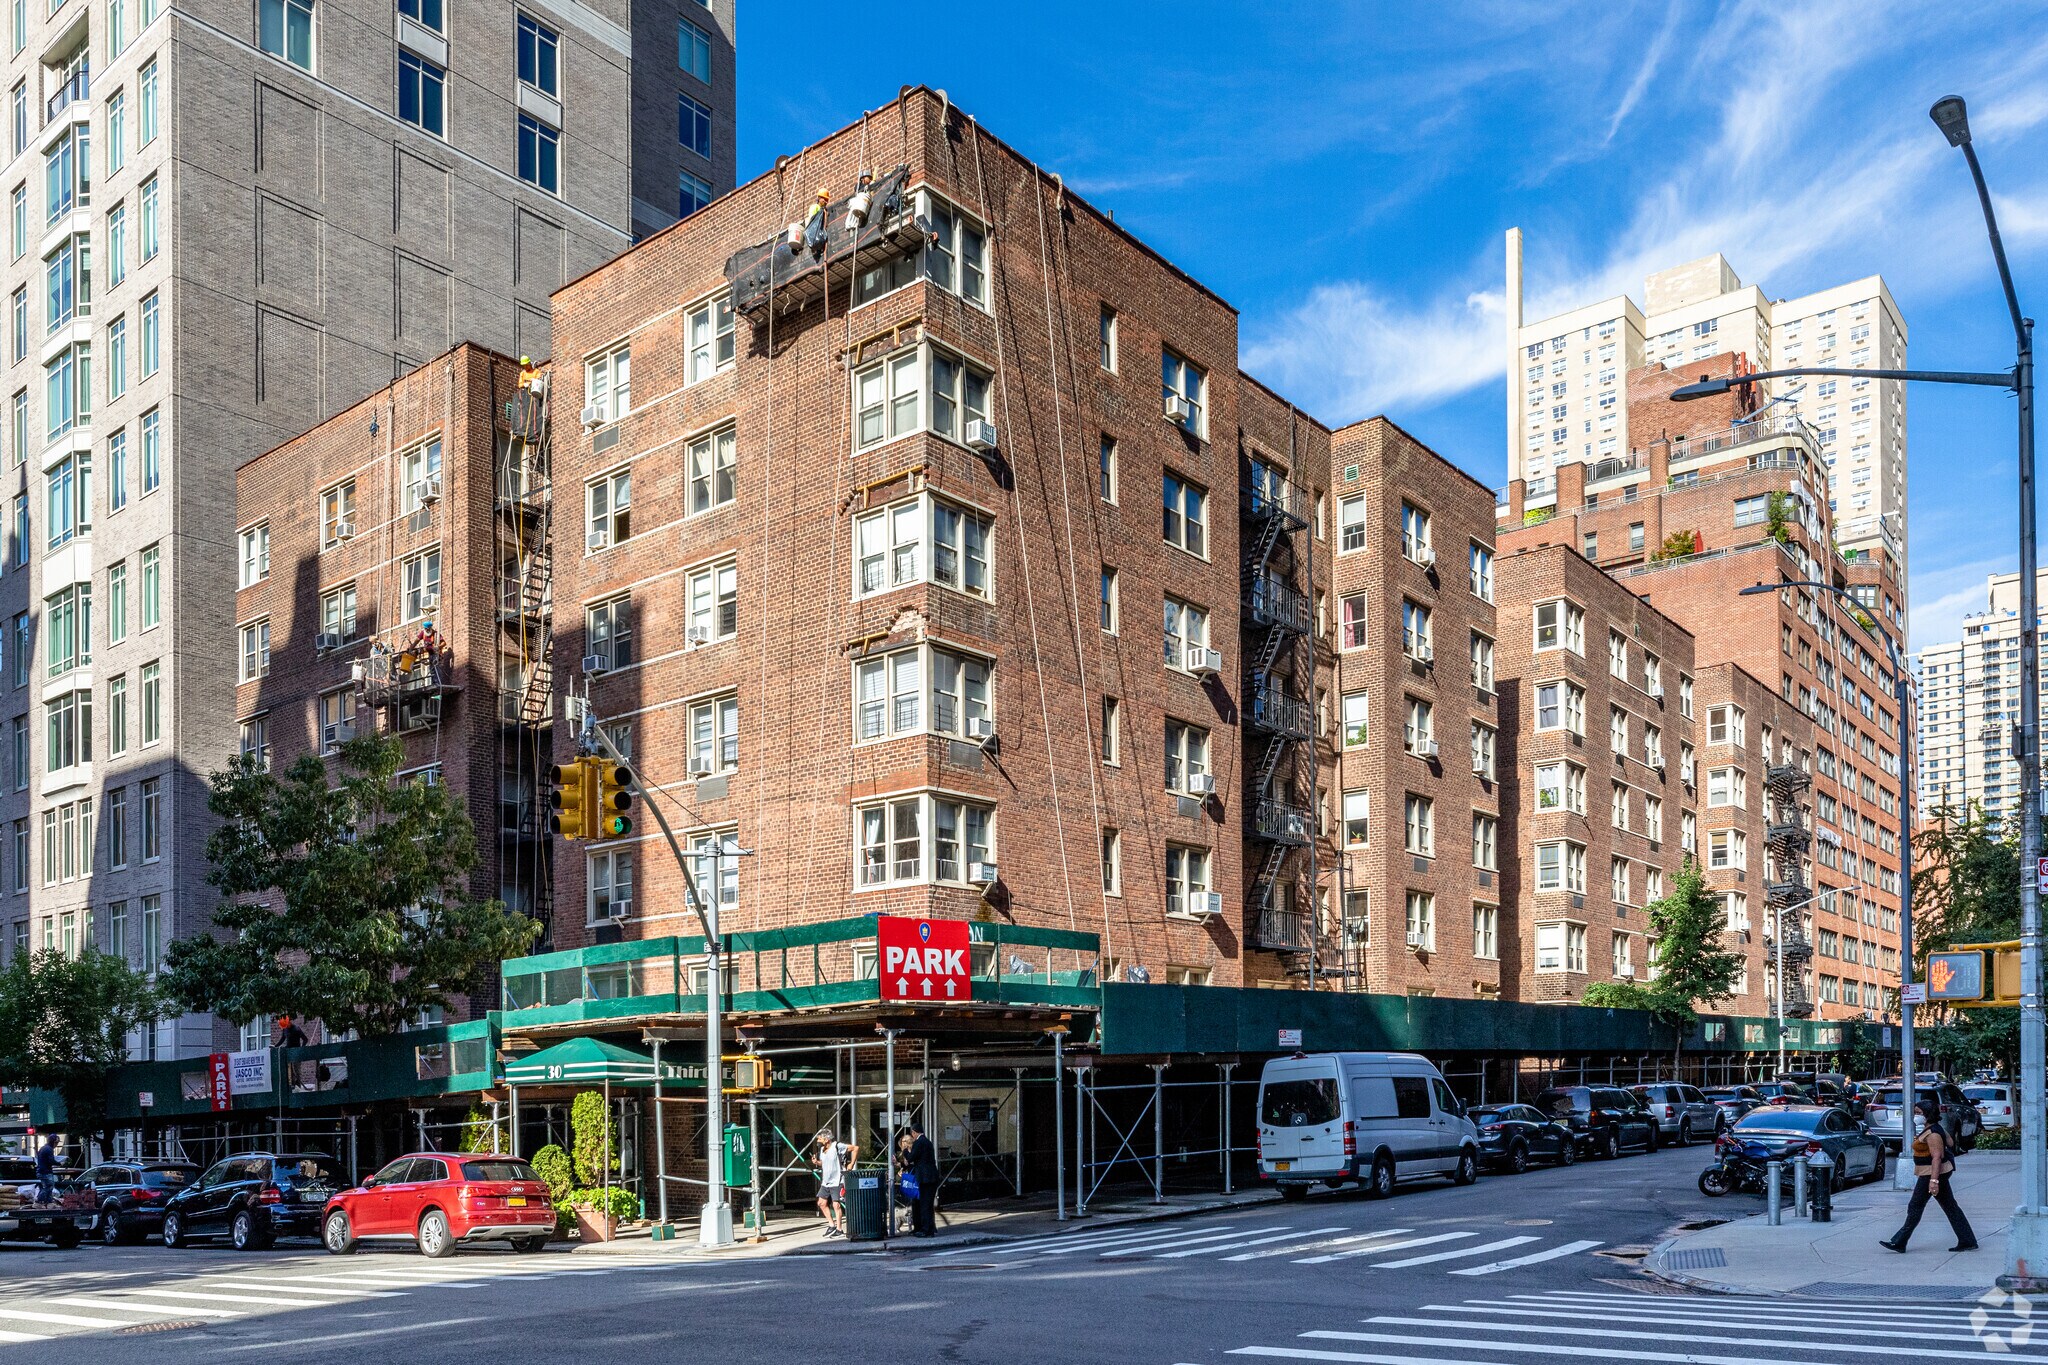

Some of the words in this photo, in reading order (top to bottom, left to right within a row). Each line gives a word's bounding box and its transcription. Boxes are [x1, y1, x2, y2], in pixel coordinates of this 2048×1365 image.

[886, 946, 966, 976] PARK
[215, 1063, 227, 1100] PARK
[235, 1068, 252, 1079] JASCO
[547, 1065, 562, 1079] 30
